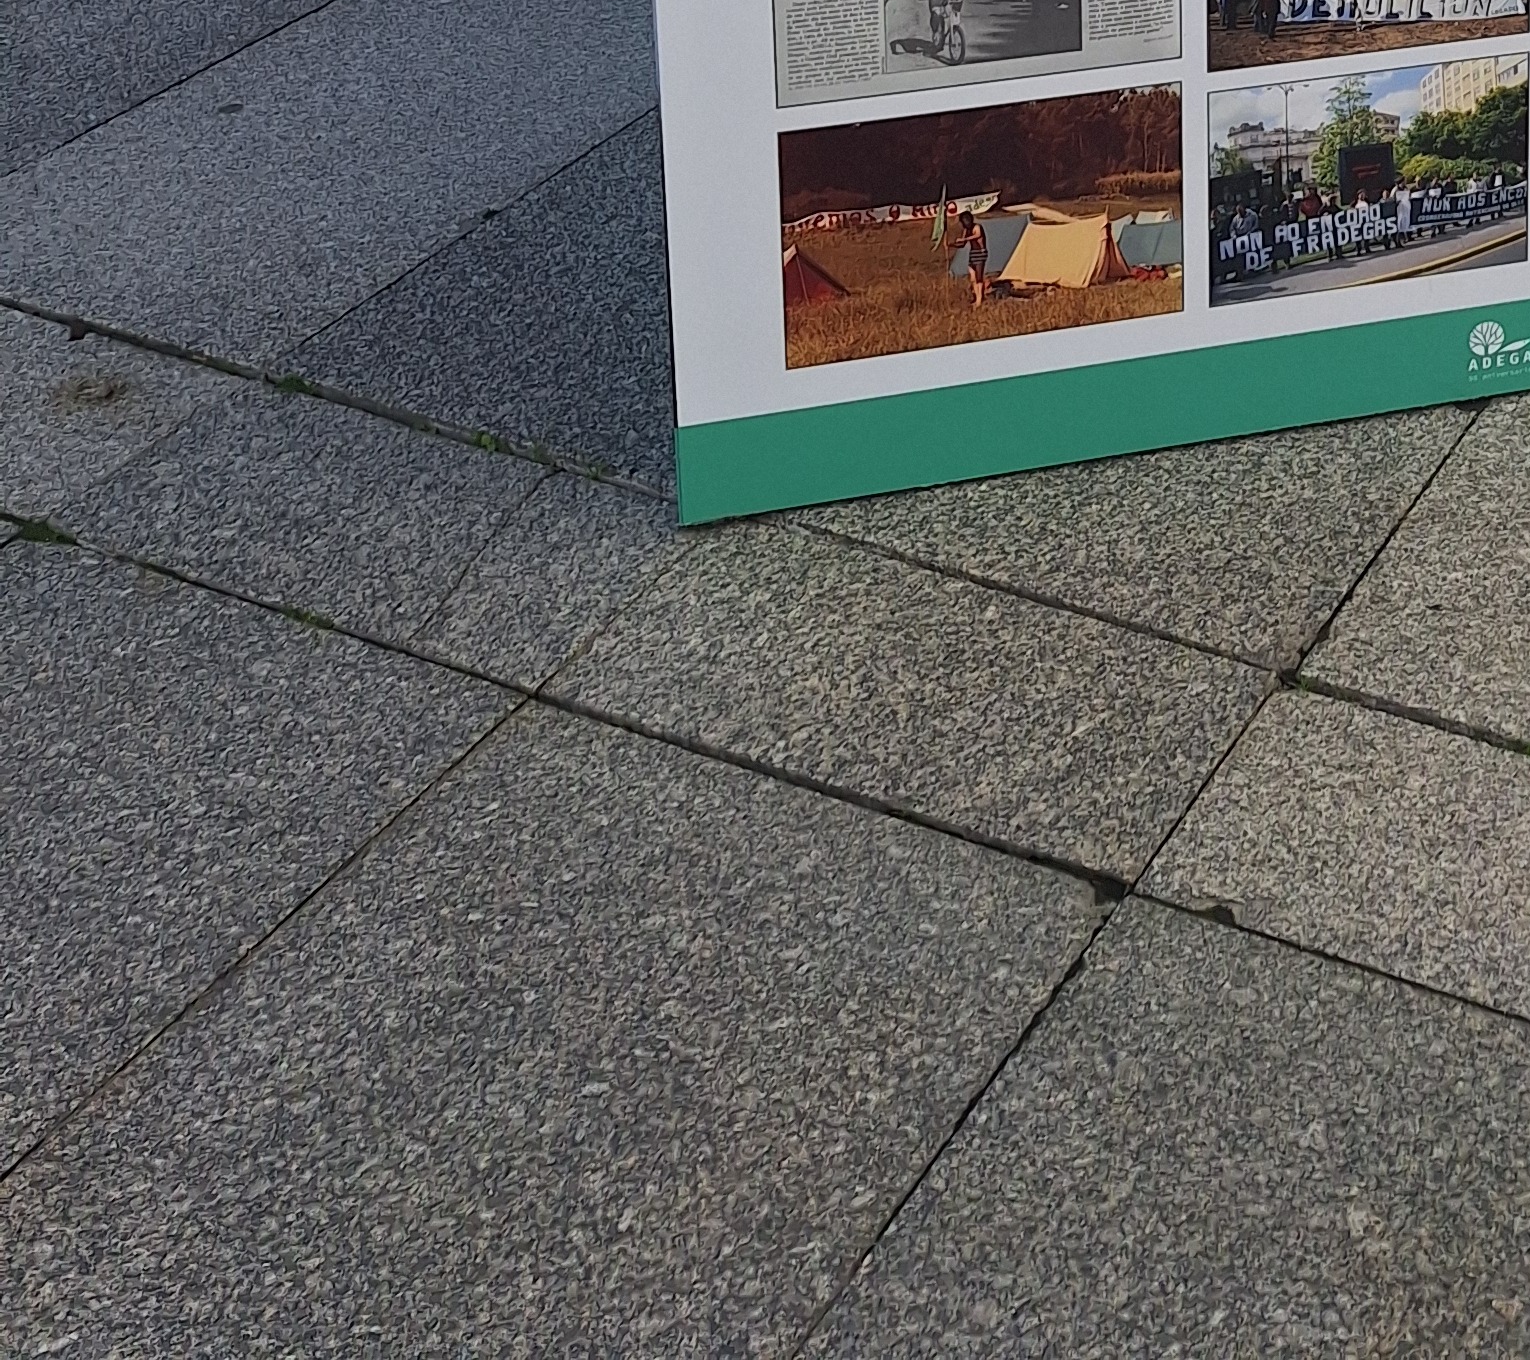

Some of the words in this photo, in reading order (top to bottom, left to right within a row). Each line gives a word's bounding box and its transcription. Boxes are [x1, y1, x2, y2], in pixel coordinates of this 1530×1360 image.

[1219, 231, 1263, 261] NON
[1275, 222, 1300, 244] AO
[1307, 203, 1381, 236] ENCORO
[1244, 246, 1273, 271] DE
[1291, 216, 1398, 258] FRADEGAS
